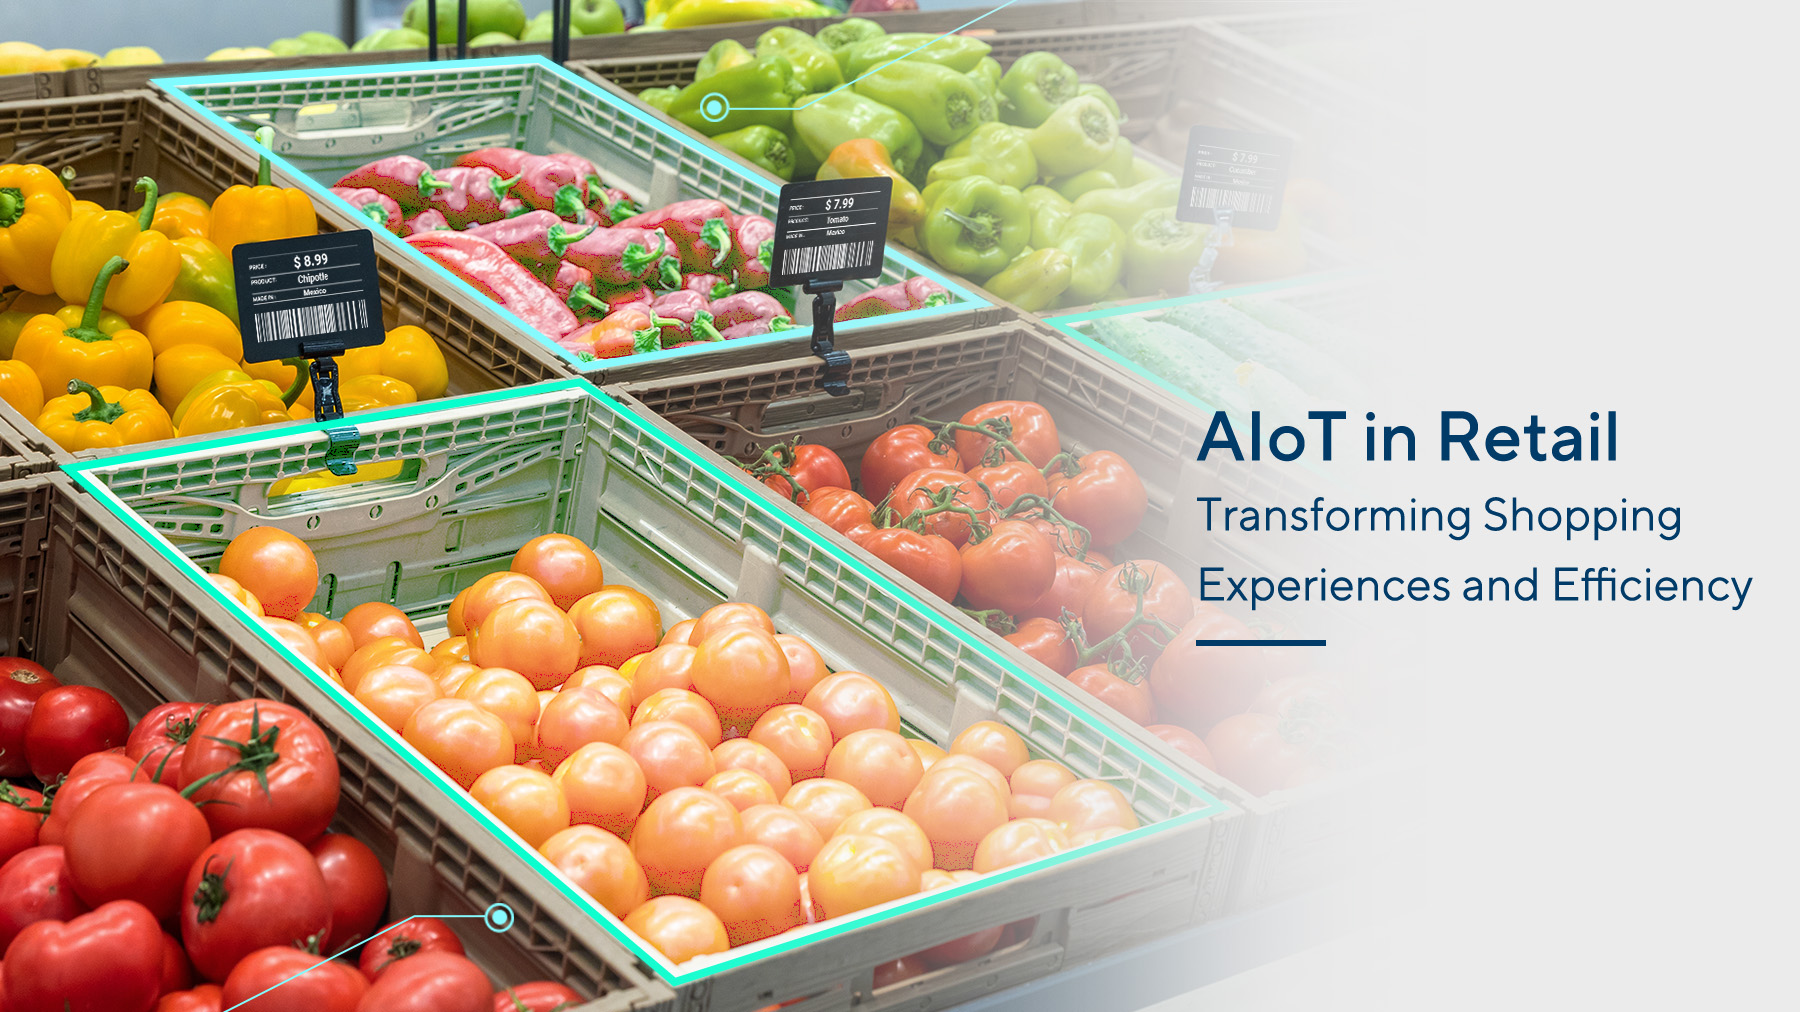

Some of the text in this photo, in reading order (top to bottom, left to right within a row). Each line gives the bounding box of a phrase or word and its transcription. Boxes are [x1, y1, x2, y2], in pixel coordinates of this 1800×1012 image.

[826, 215, 850, 224] Tomato
[298, 272, 329, 284] Chipotle
[303, 288, 327, 296] Mexico
